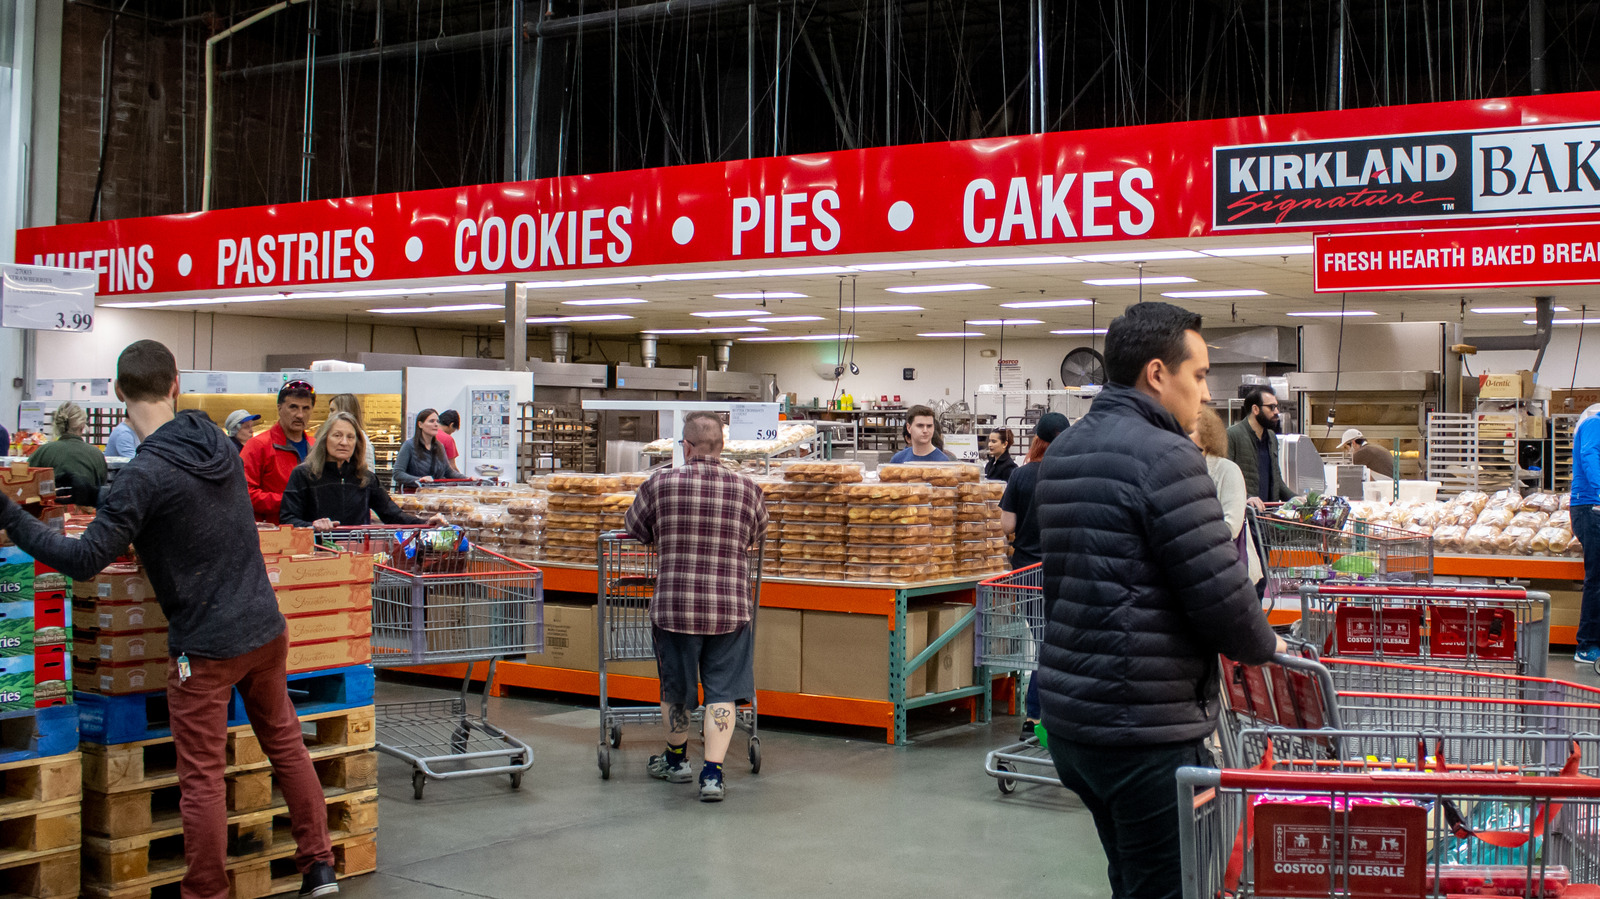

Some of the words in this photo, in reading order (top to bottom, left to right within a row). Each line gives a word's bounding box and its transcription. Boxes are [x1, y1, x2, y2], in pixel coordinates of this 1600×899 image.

[1230, 145, 1457, 193] KIRKLAND
[1227, 188, 1455, 224] Signature
[217, 226, 375, 286] PASTRIES
[454, 206, 632, 272] COOKIES
[732, 189, 841, 256] PIES
[963, 167, 1155, 244] CAKES
[1324, 251, 1382, 272] FRESH
[1389, 247, 1465, 269] HEARTH
[1472, 244, 1536, 266] BAKED
[1543, 241, 1600, 263] BREA
[55, 312, 92, 330] 3.99
[756, 429, 778, 440] 5.99
[963, 450, 979, 459] 5.99
[1274, 863, 1325, 874] COSTCO
